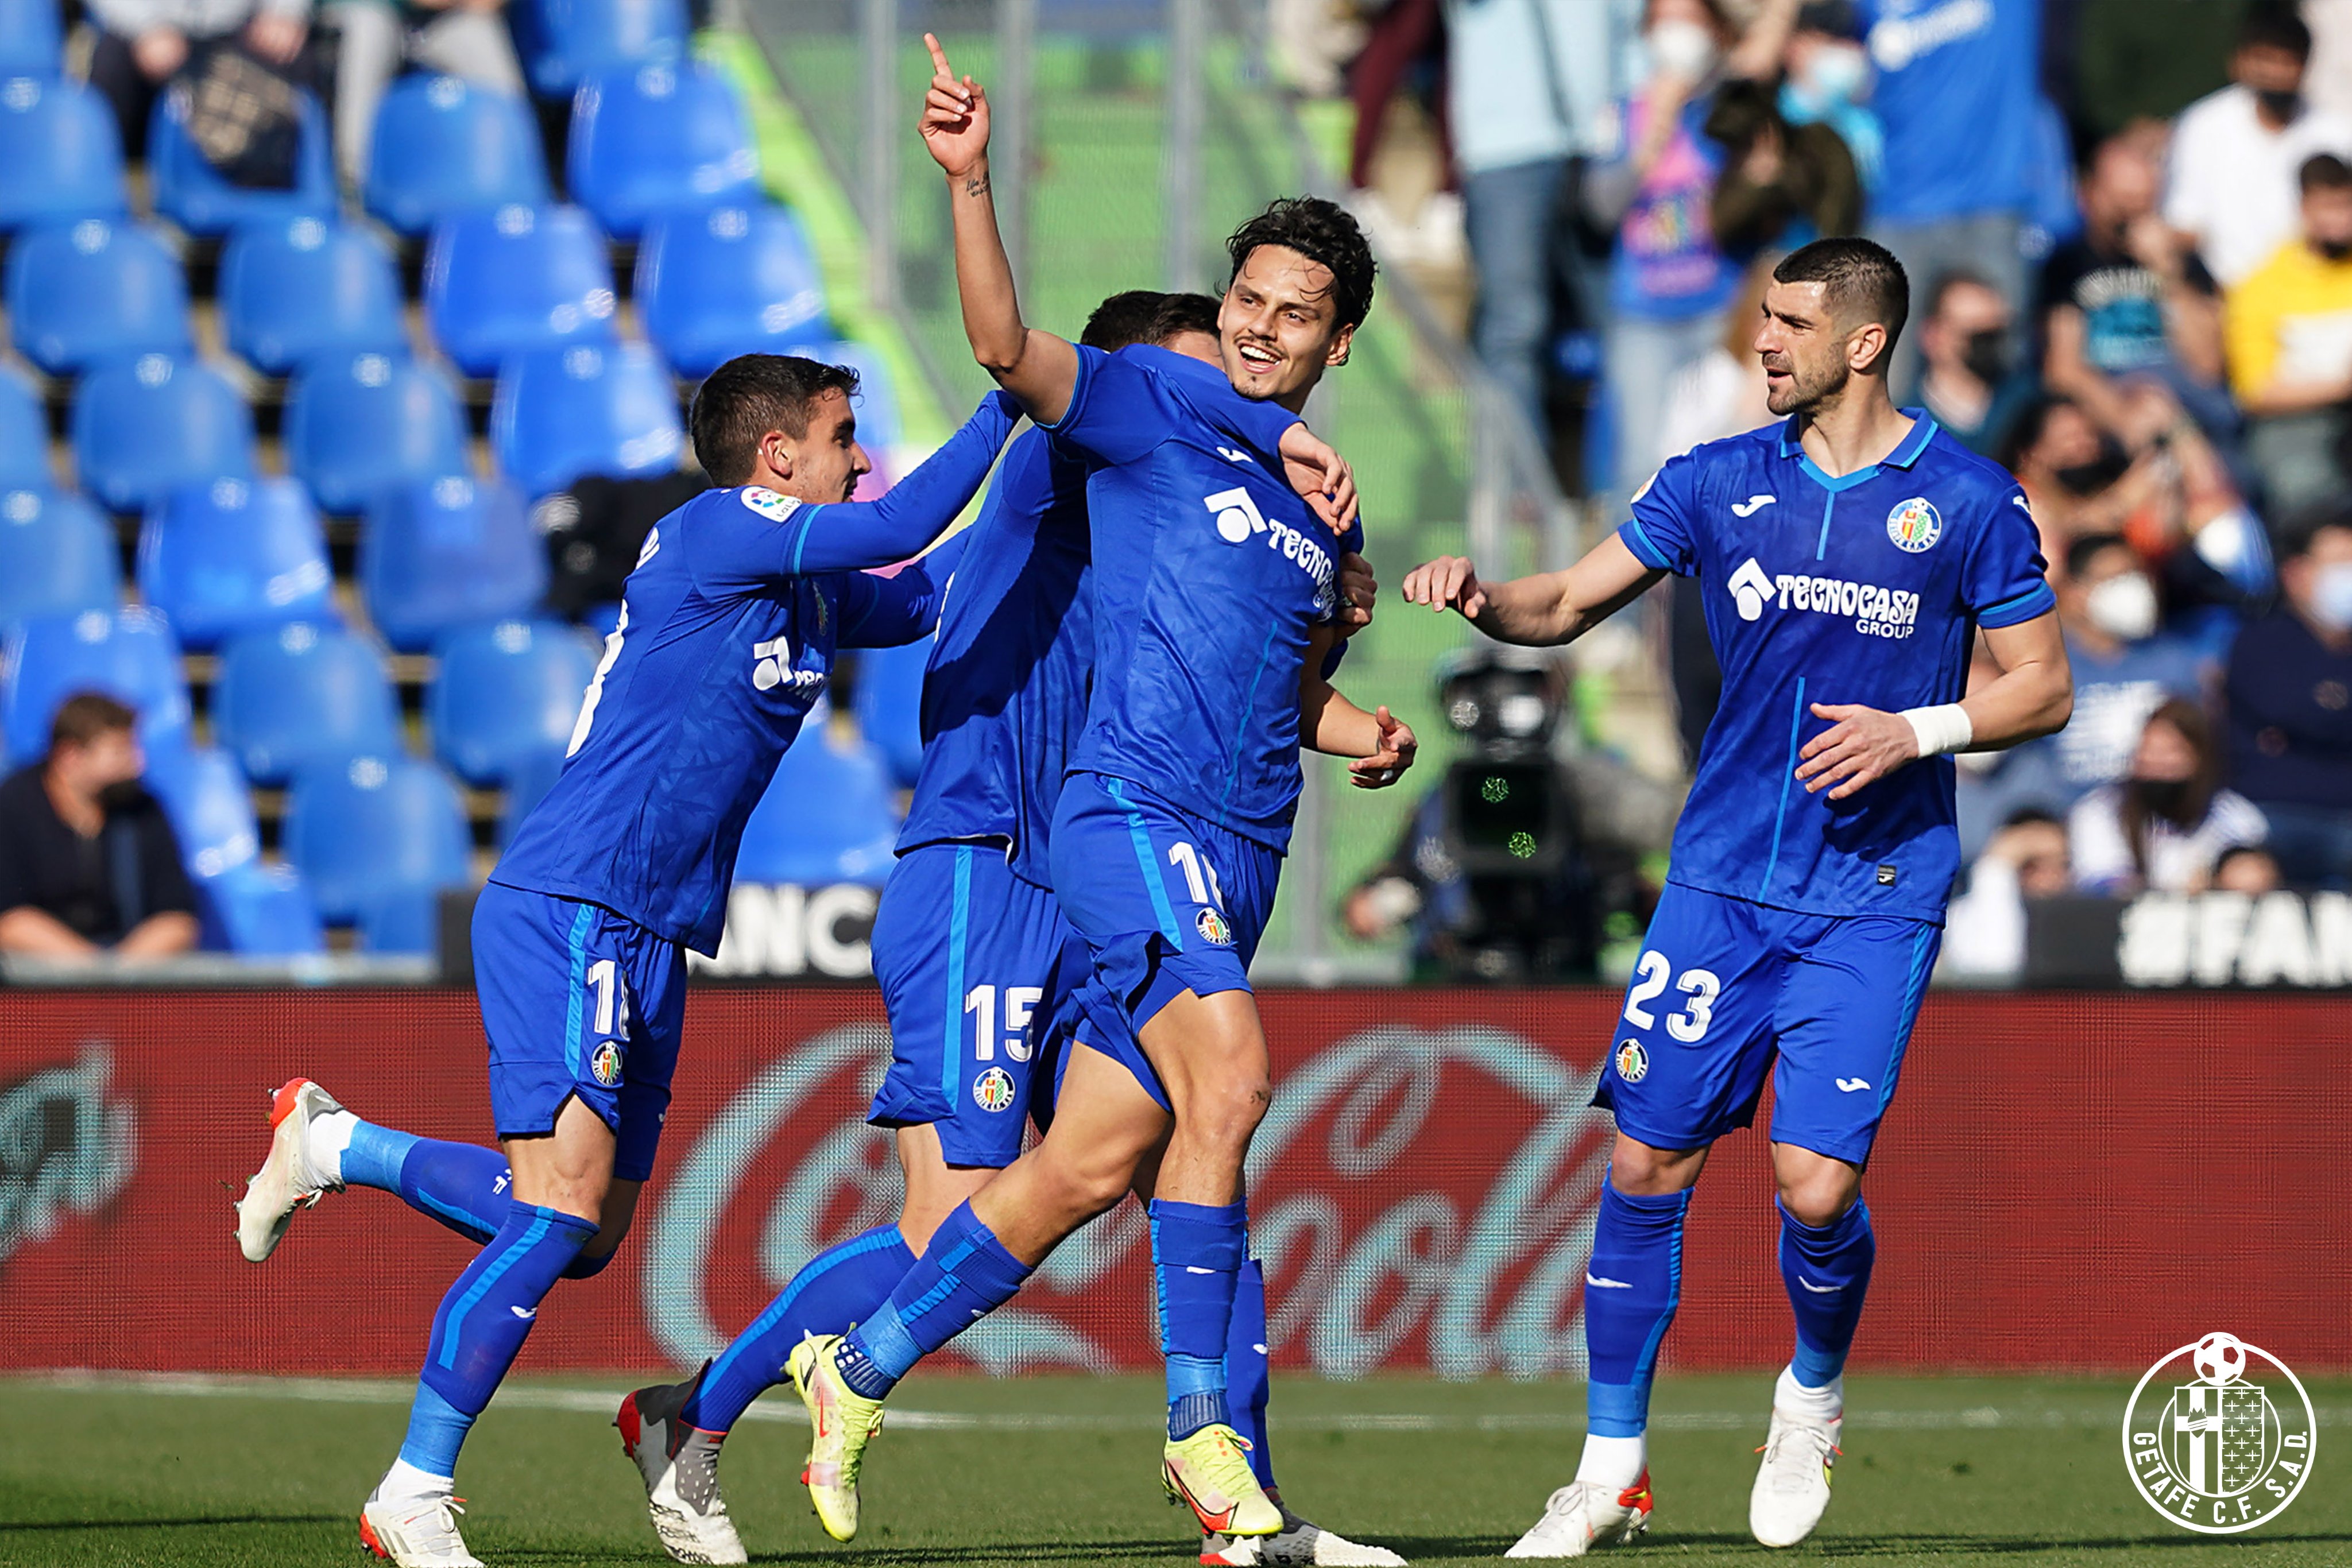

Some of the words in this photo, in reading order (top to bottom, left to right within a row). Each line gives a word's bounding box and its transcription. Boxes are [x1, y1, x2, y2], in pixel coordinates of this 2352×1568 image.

[1775, 575, 1920, 625] TECNOCASA
[1855, 619, 1914, 640] GROUP
[965, 984, 1043, 1063] 15
[1623, 950, 1721, 1043] 23
